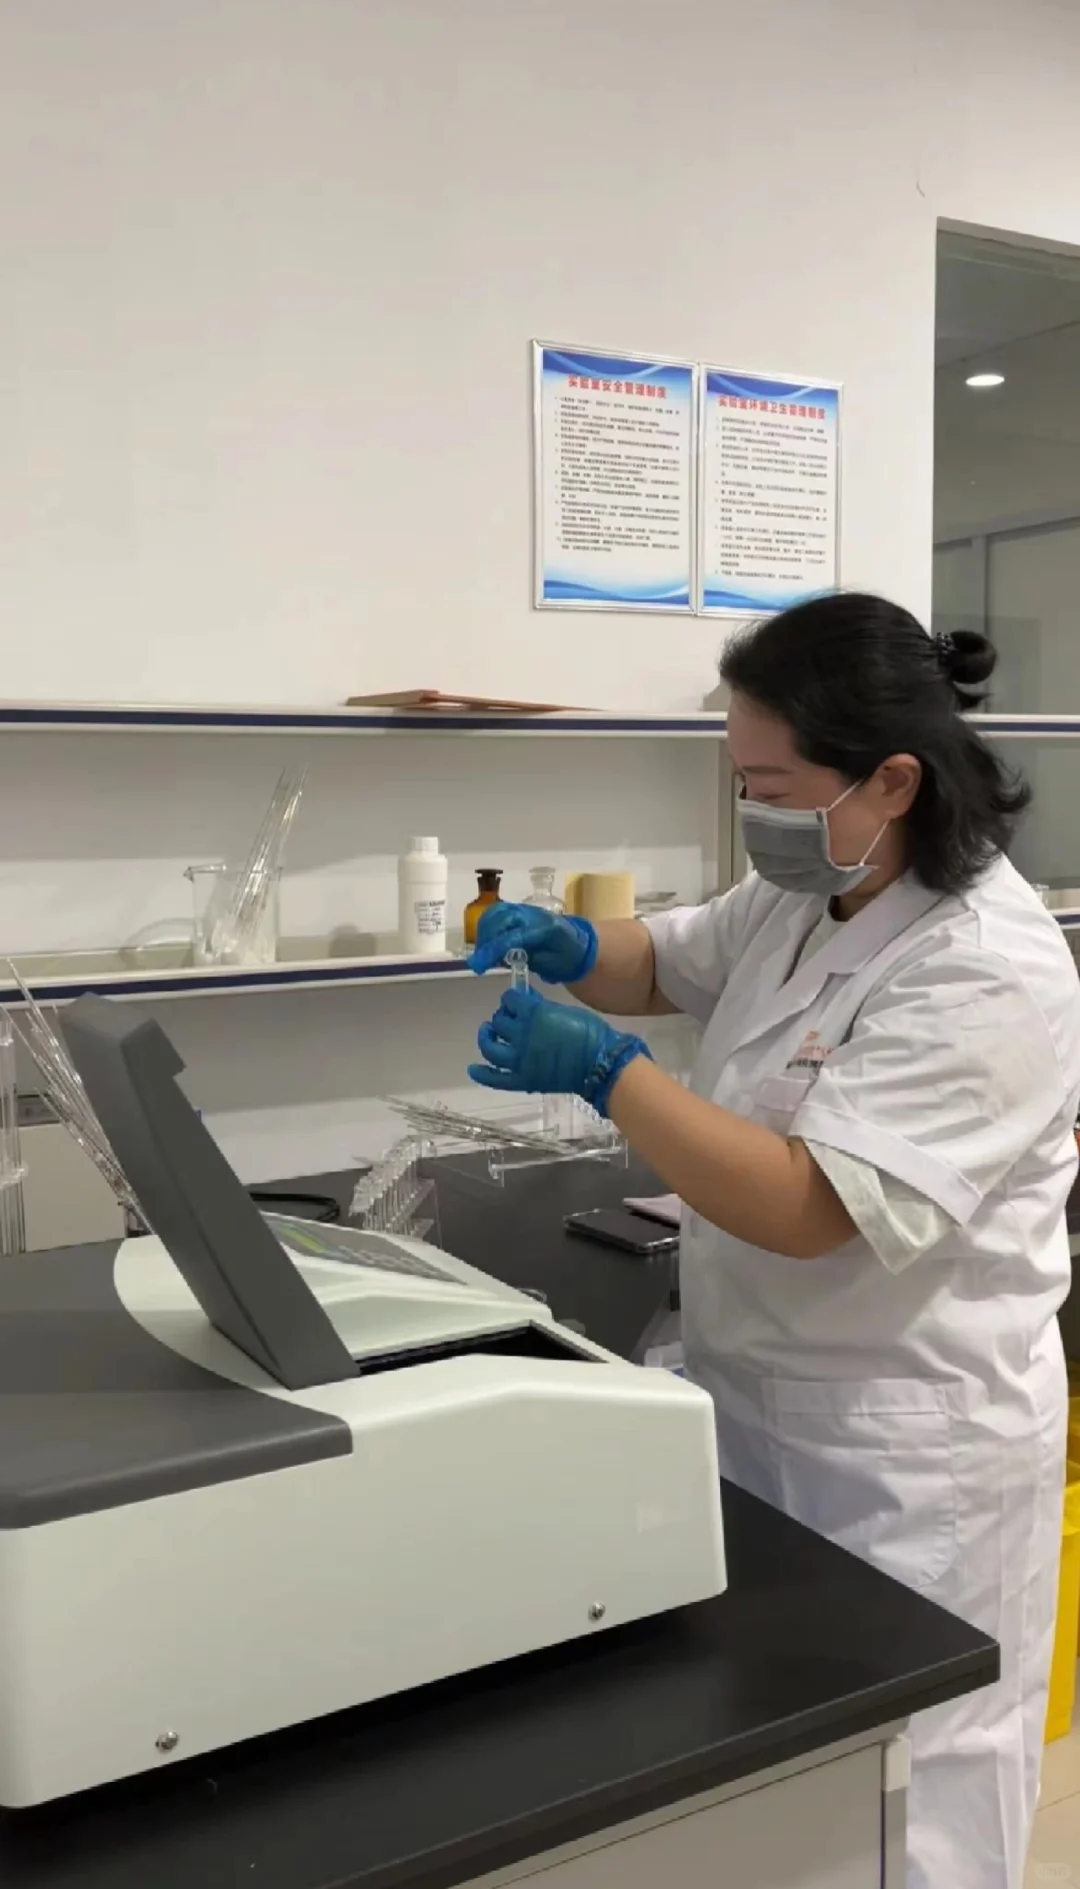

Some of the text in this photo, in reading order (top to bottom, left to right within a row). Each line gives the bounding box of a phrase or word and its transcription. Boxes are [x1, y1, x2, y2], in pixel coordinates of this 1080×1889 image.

[568, 374, 666, 398] 实验室安全管理制度
[718, 395, 825, 420] 实验室环境卫生管理制度
